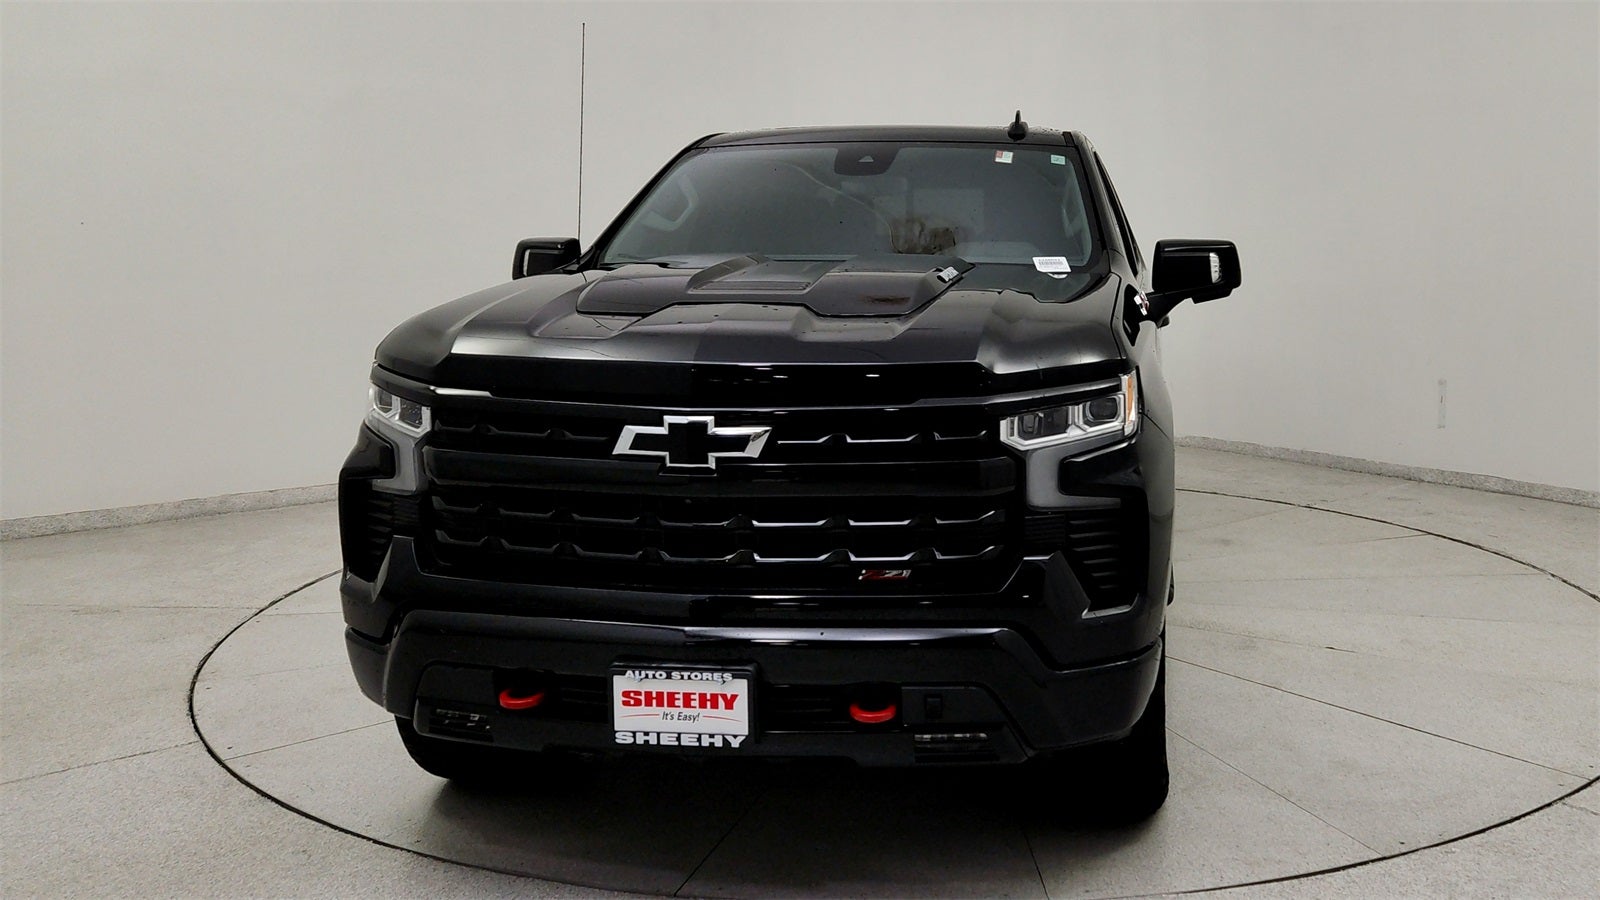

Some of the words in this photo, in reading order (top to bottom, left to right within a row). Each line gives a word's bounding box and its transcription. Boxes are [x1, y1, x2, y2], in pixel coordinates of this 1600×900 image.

[624, 670, 667, 680] AUTO
[671, 671, 733, 682] STORES
[621, 690, 739, 710] SHEEHY
[662, 711, 675, 721] It's
[677, 711, 700, 723] Easy!
[615, 731, 746, 748] SHEEHY
